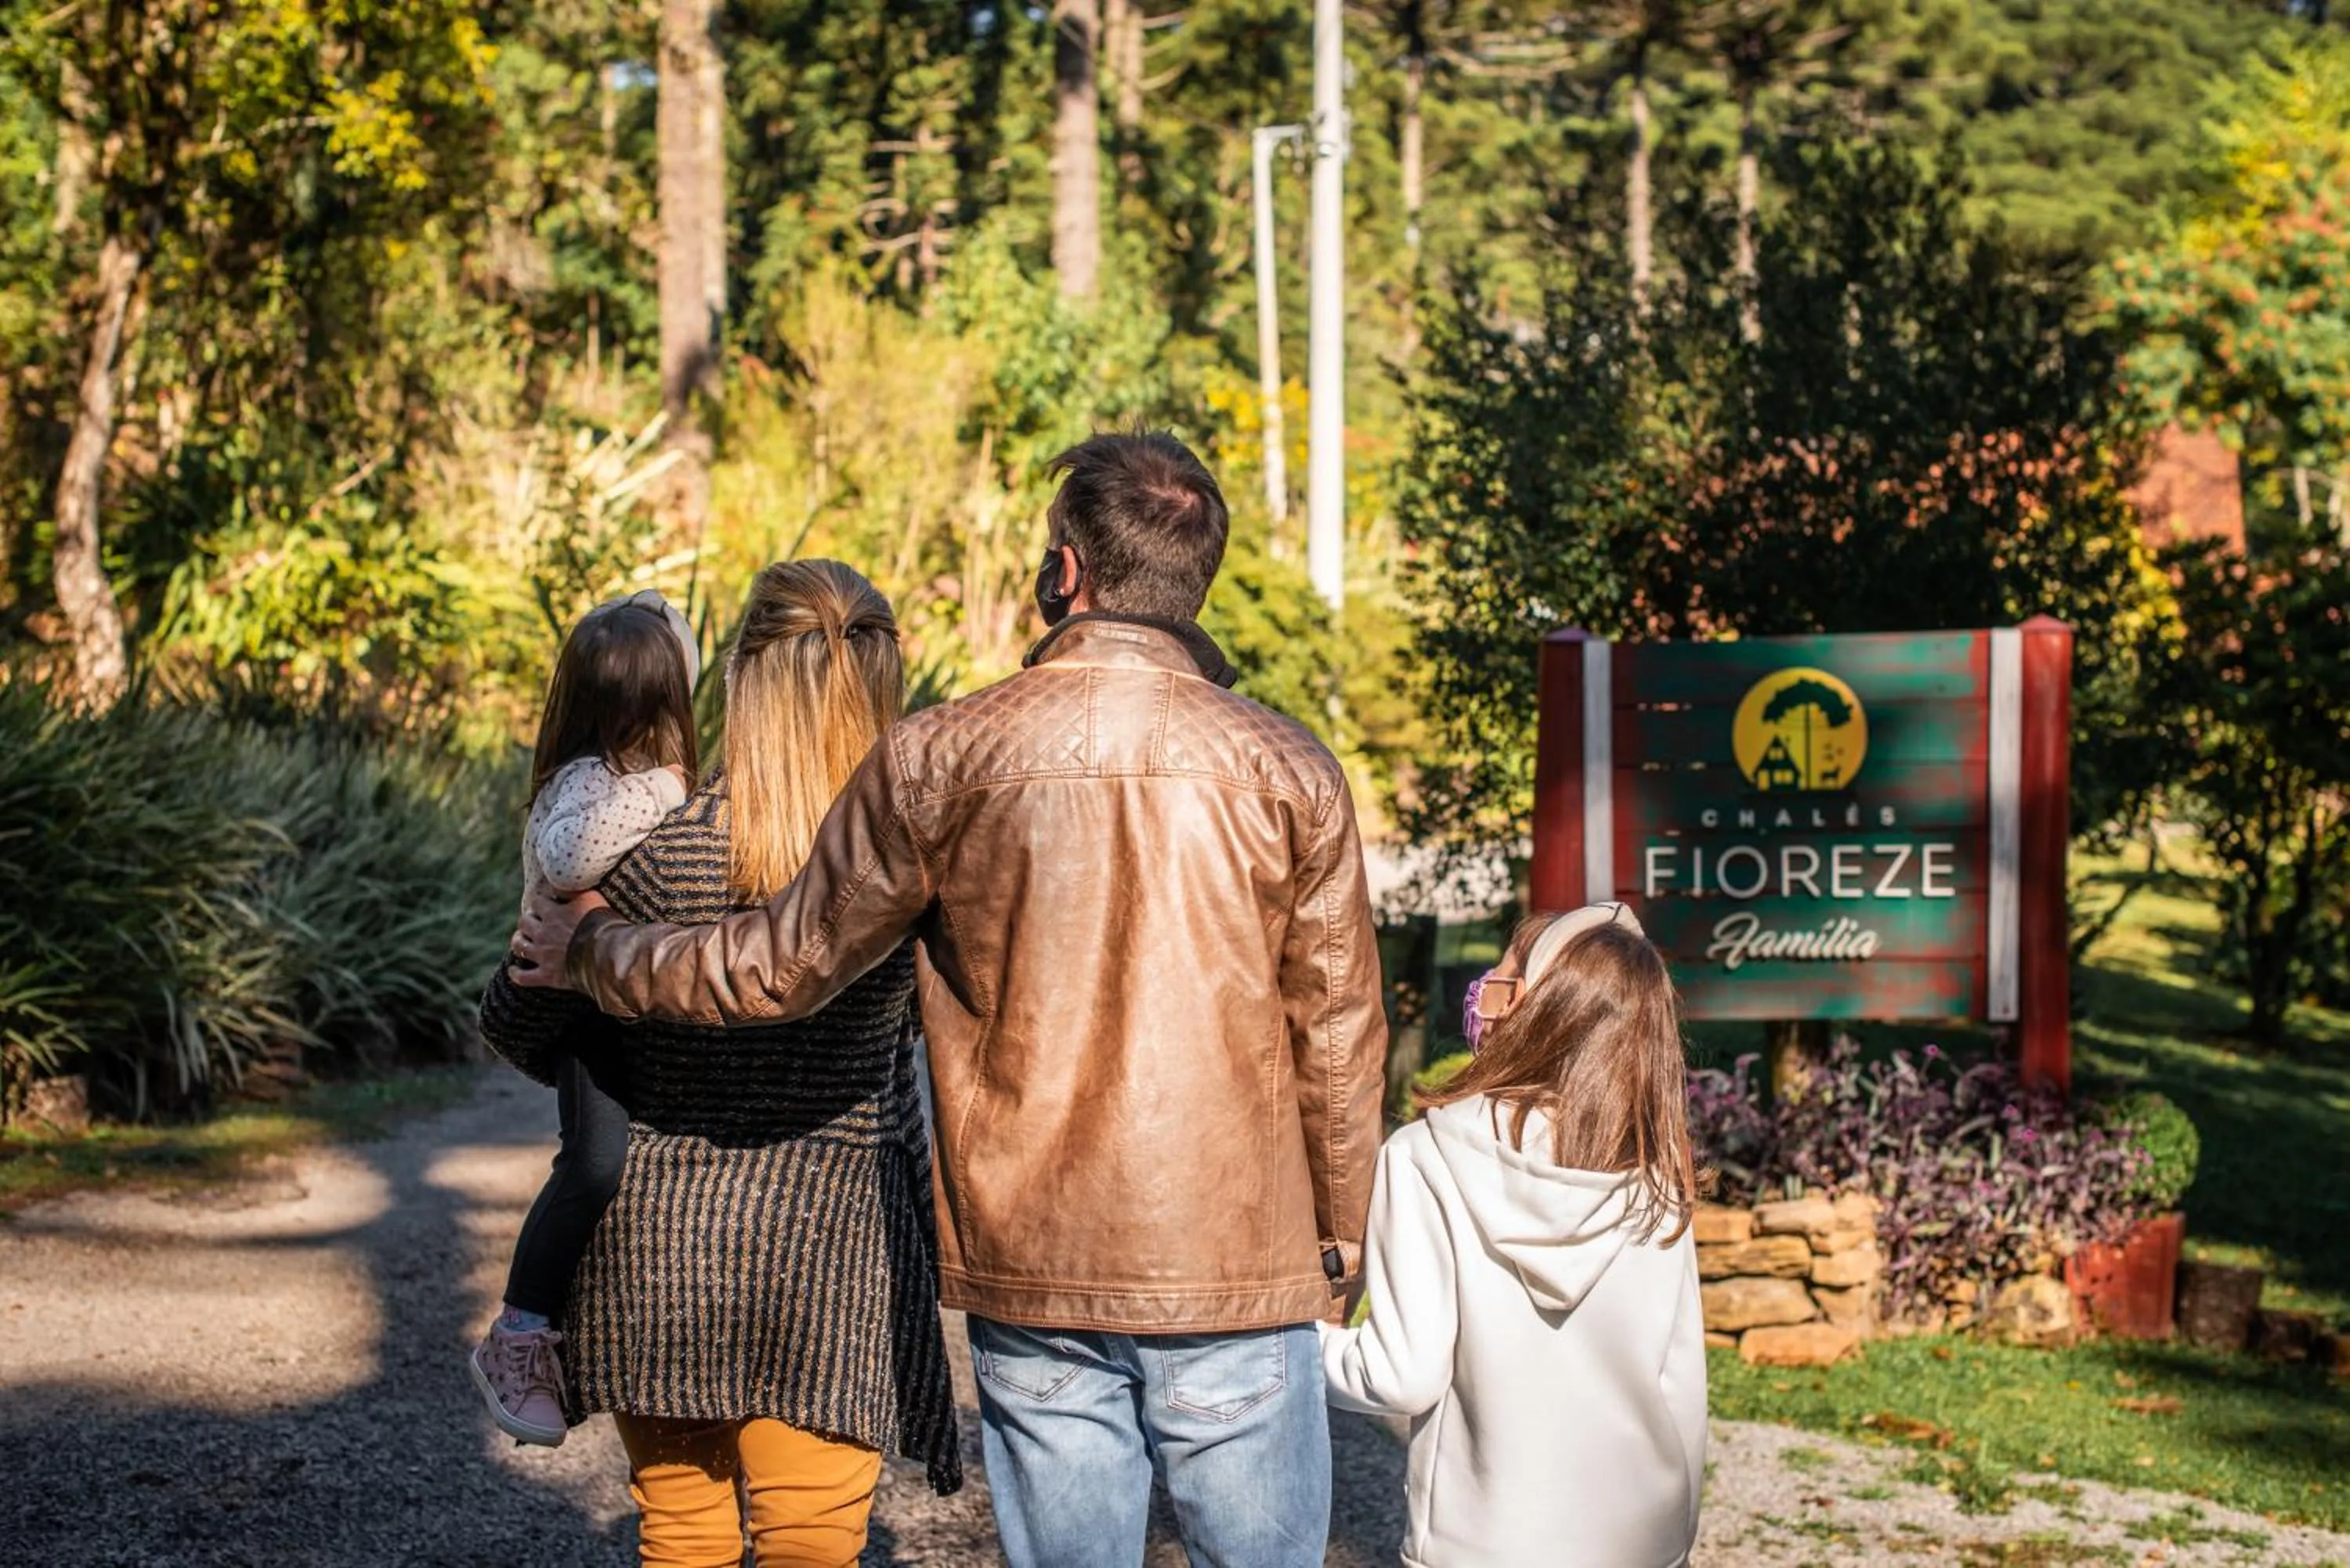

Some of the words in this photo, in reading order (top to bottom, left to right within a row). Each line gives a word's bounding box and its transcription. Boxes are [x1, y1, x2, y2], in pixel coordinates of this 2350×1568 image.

[1701, 803, 1896, 827] CHALÉS
[1646, 844, 1956, 898] FIOREZE
[1706, 912, 1880, 970] Família
